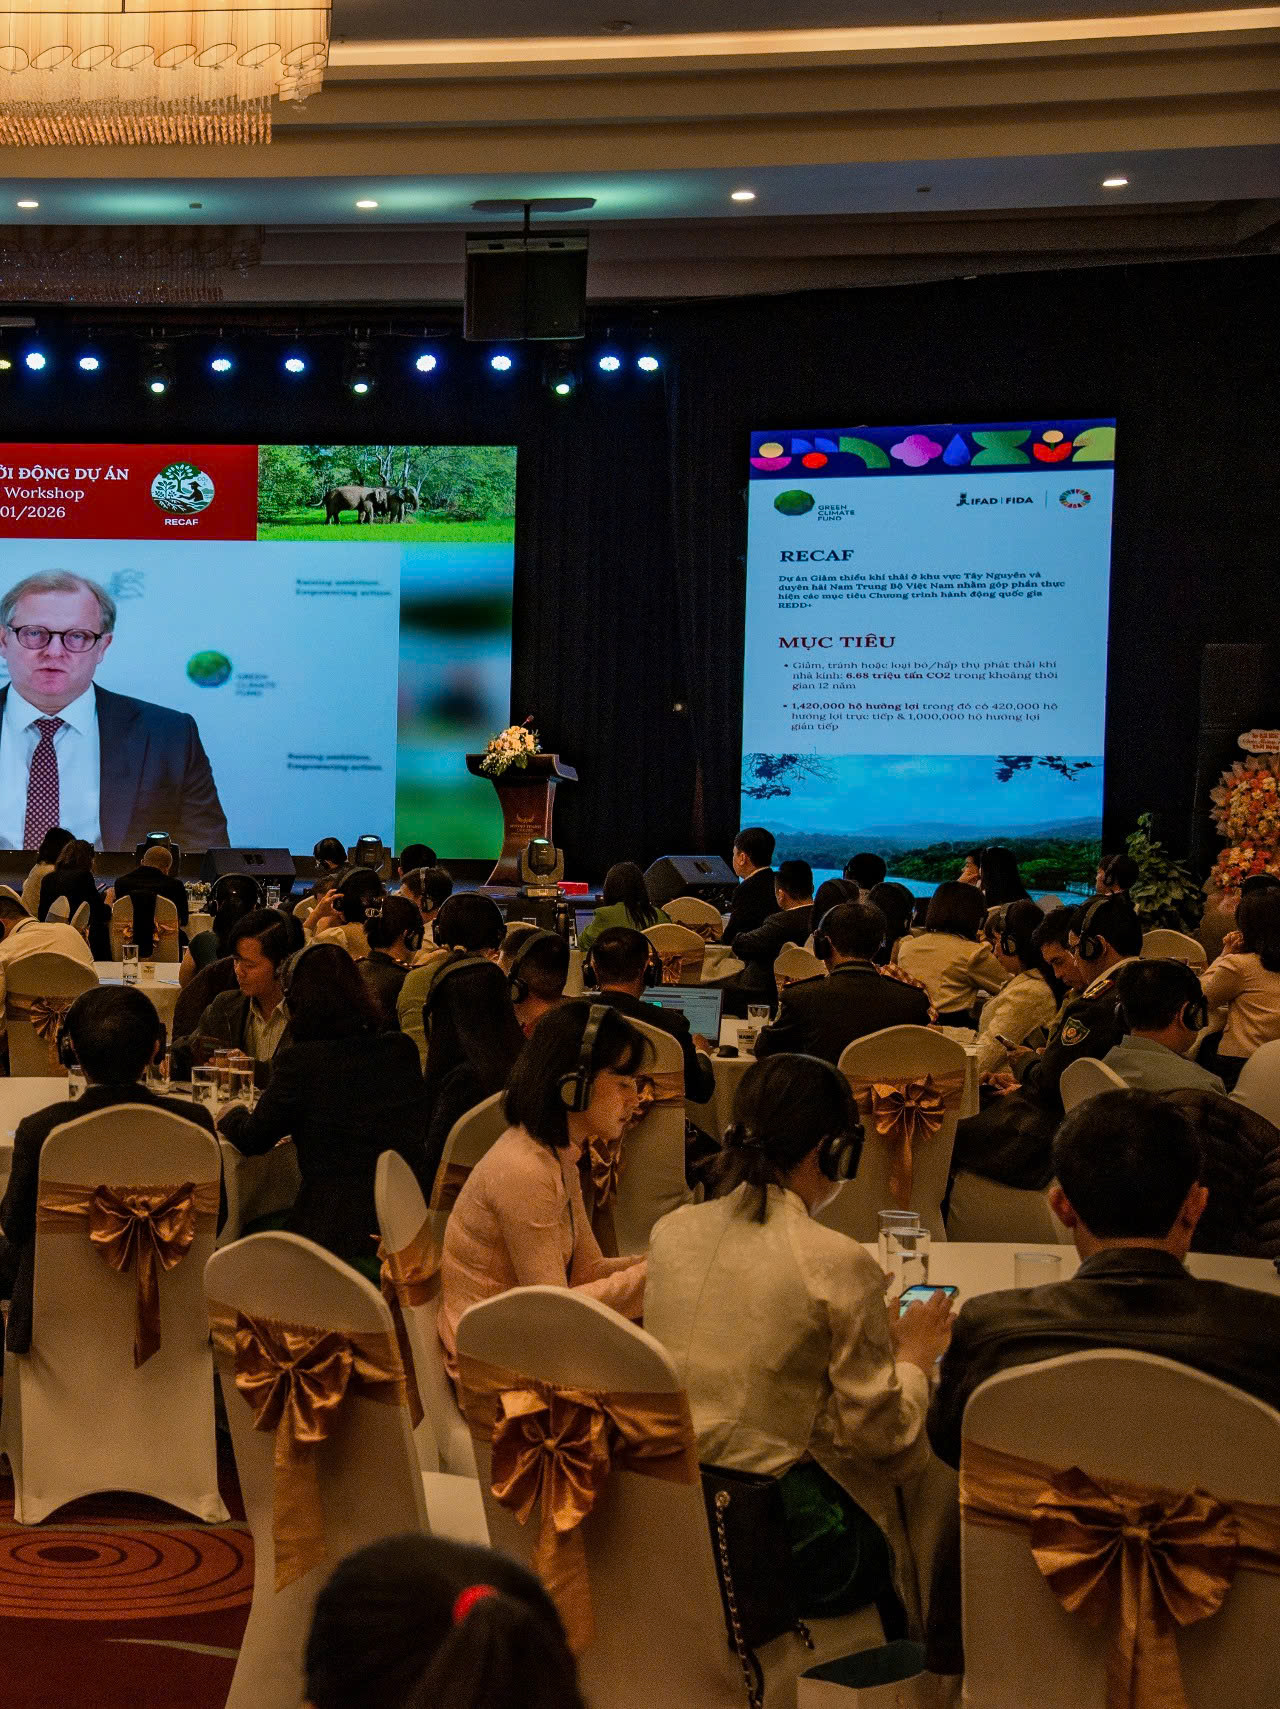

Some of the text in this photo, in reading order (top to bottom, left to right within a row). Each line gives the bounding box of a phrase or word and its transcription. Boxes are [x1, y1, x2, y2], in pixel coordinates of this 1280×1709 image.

[18, 464, 70, 482] ĐỘNG
[74, 467, 101, 482] DỰ
[104, 464, 129, 481] ÁN
[5, 487, 85, 501] Workshop
[971, 496, 1034, 505] IFAD FIDA
[780, 549, 855, 562] RECAF
[840, 573, 866, 581] thiểu
[964, 572, 983, 580] Tây
[986, 572, 1026, 580] Nguyên
[778, 583, 809, 592] duyên
[856, 583, 887, 591] Trung
[890, 583, 903, 591] Bộ
[869, 592, 909, 600] Chương
[969, 591, 996, 599] động
[999, 589, 1024, 599] quốc
[1027, 590, 1042, 598] gia
[778, 633, 896, 651] MỤC TIÊU
[954, 672, 986, 680] trong
[922, 703, 954, 711] trong
[991, 703, 1040, 711] 420,000
